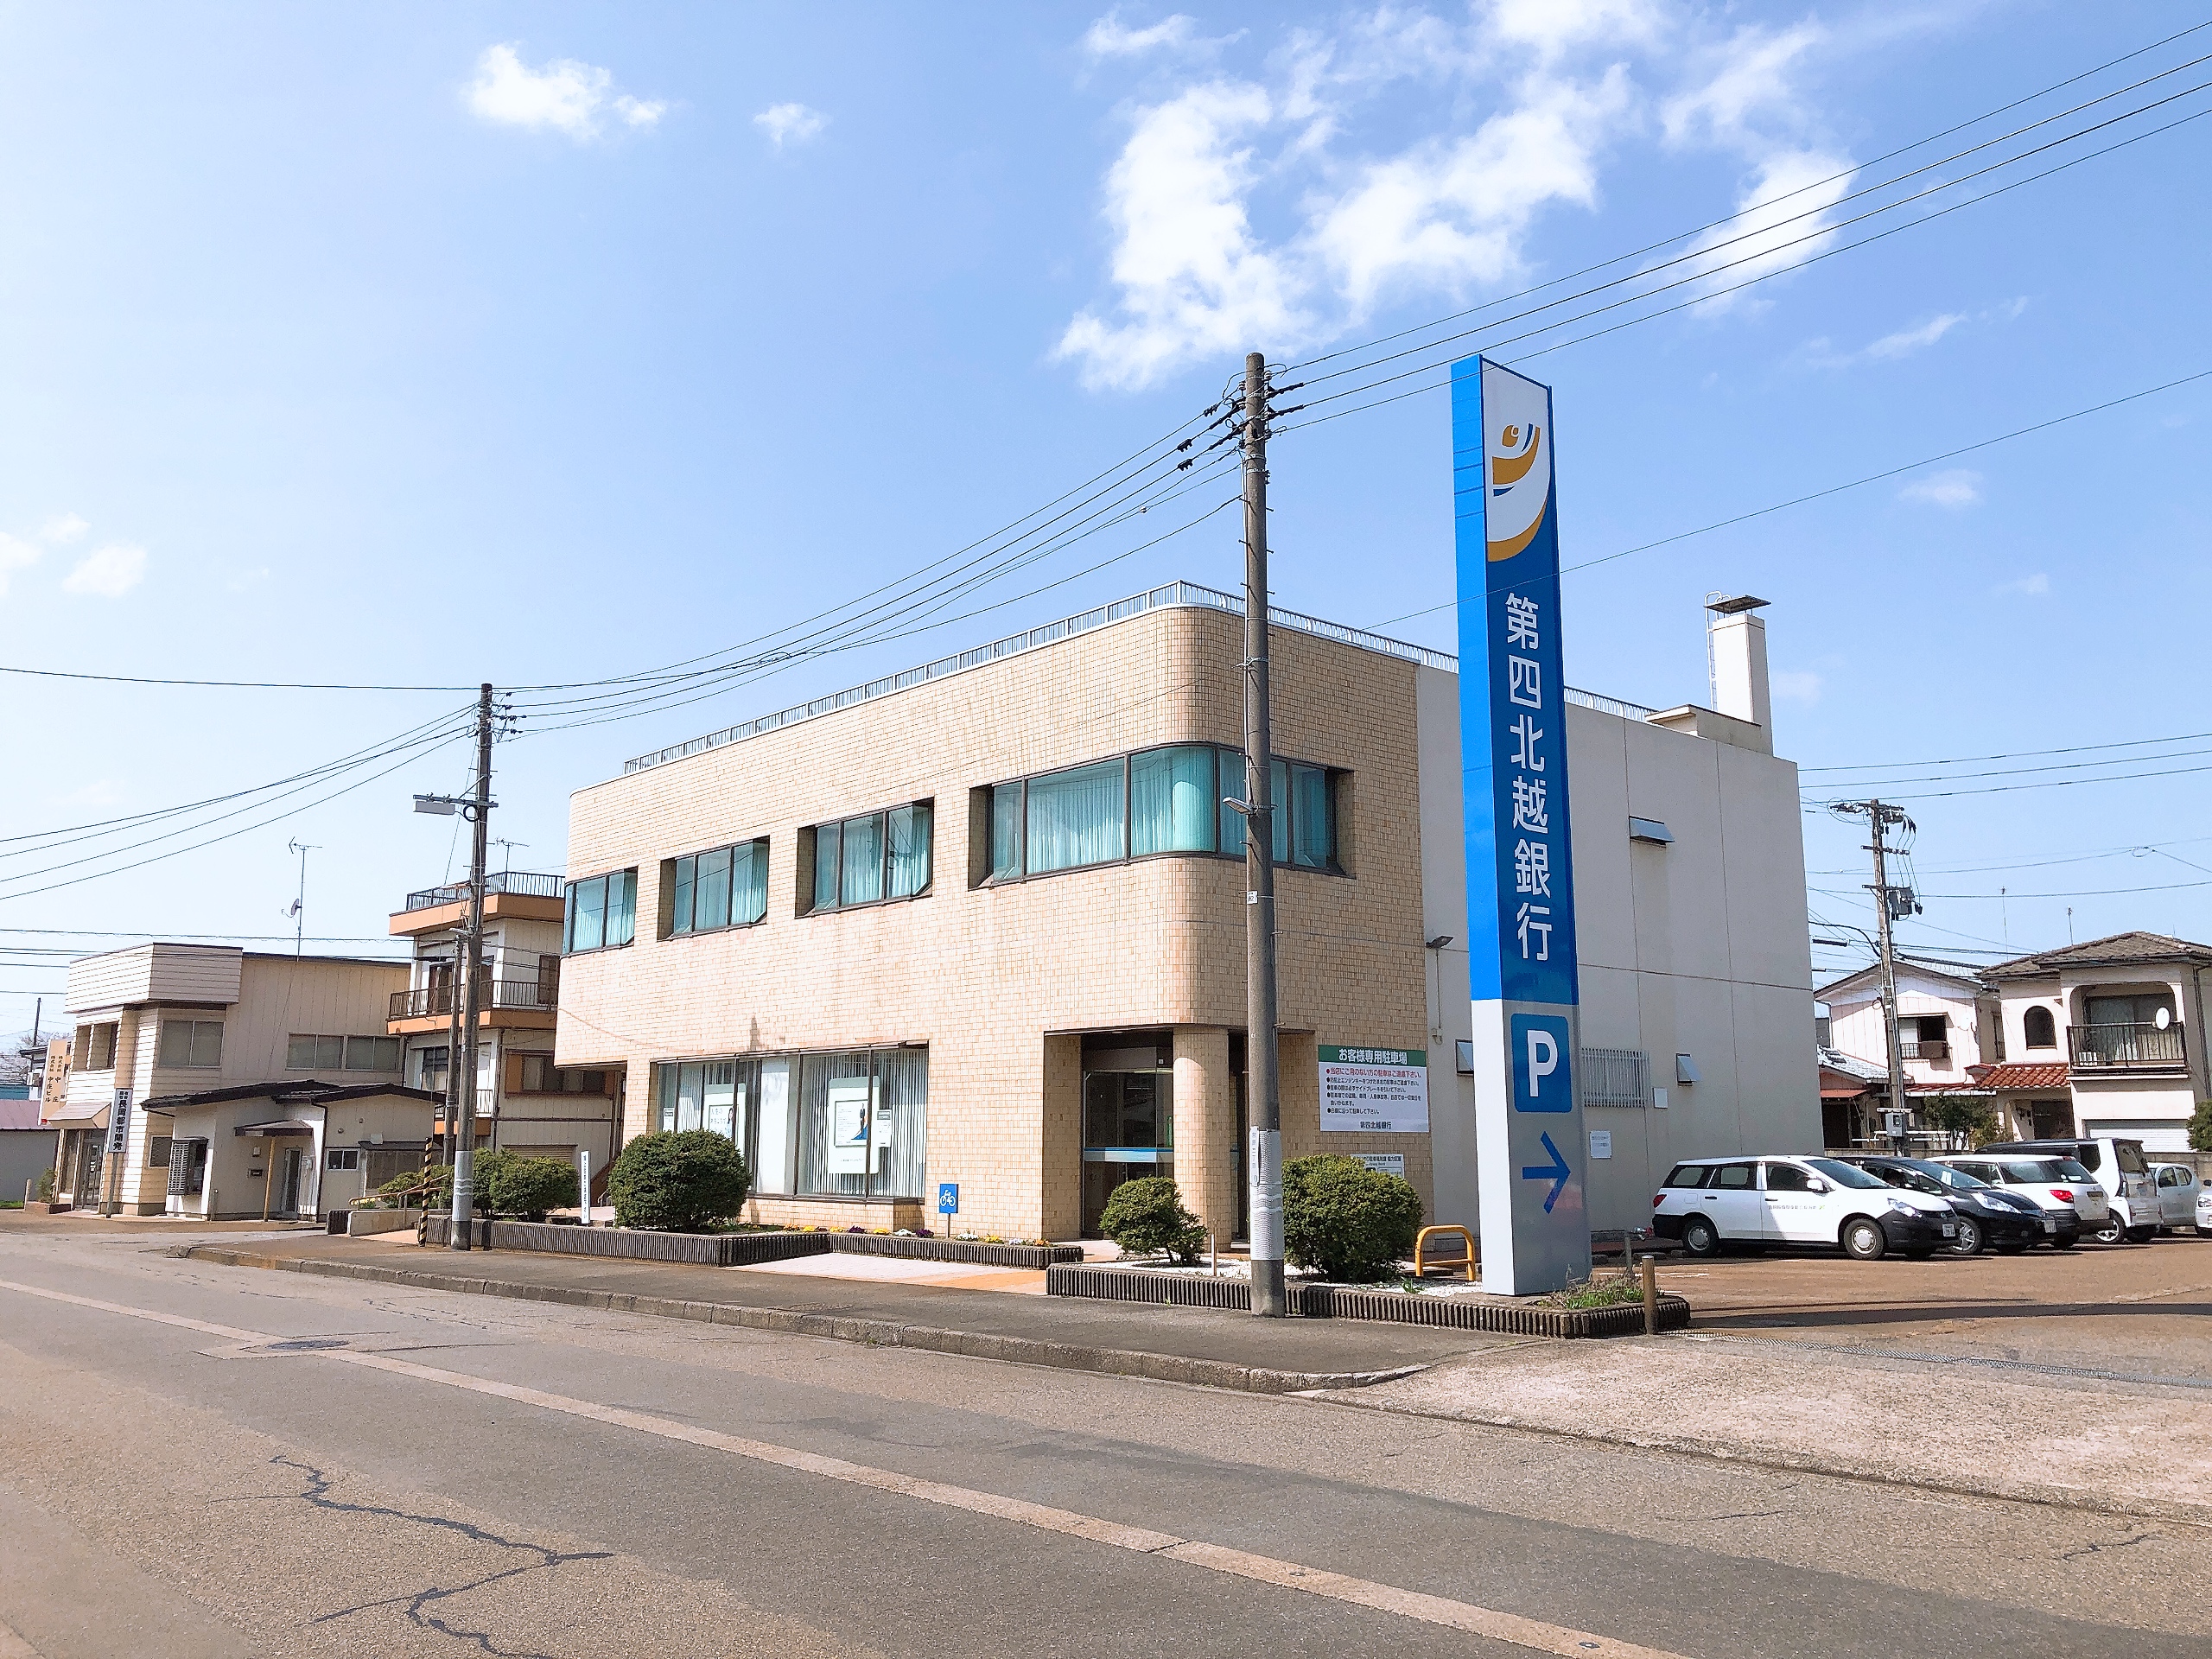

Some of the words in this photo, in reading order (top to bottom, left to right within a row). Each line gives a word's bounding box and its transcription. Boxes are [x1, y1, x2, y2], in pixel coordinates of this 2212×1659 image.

[1504, 592, 1553, 963] 第四北越銀行
[1339, 1048, 1408, 1065] お客様専用駐車場
[1527, 1030, 1558, 1097] P
[113, 1100, 127, 1150] 長岡都市開発
[1360, 1121, 1392, 1129] 第四北越銀行
